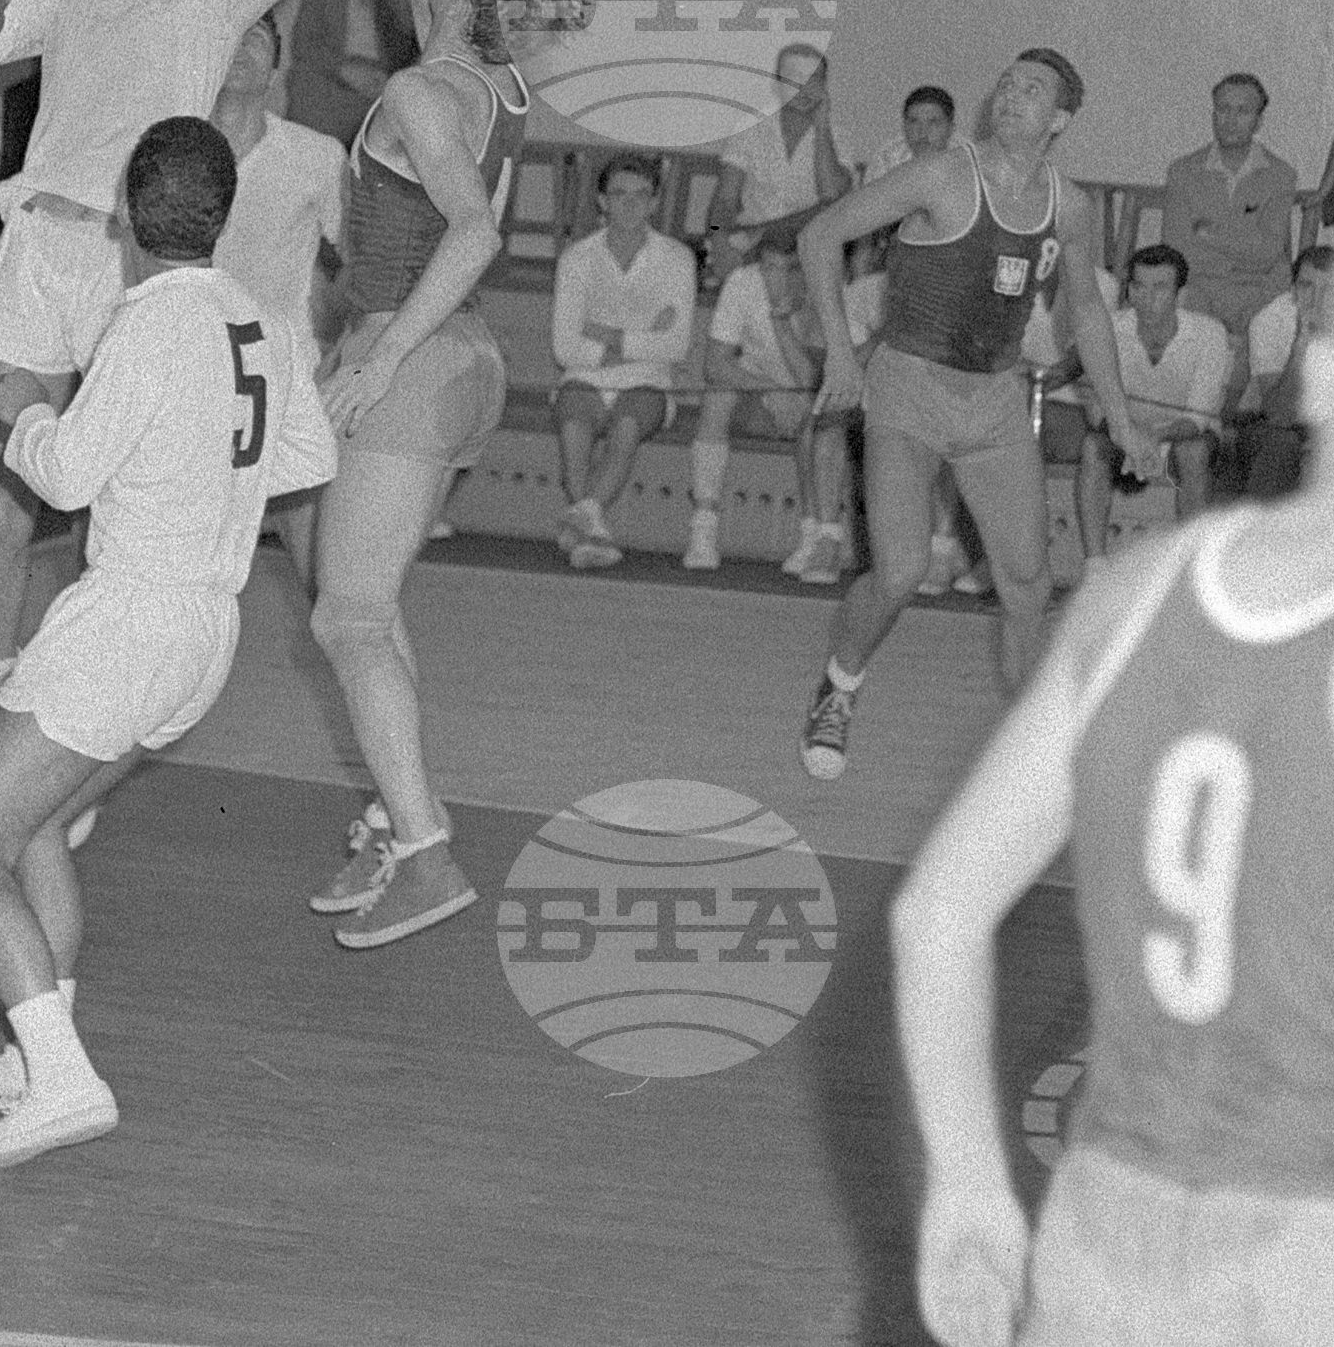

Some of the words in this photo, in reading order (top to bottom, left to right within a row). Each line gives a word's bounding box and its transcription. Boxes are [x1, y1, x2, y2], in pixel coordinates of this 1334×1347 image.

[1035, 238, 1060, 281] 8
[225, 321, 266, 469] 5
[1143, 732, 1252, 1023] 9
